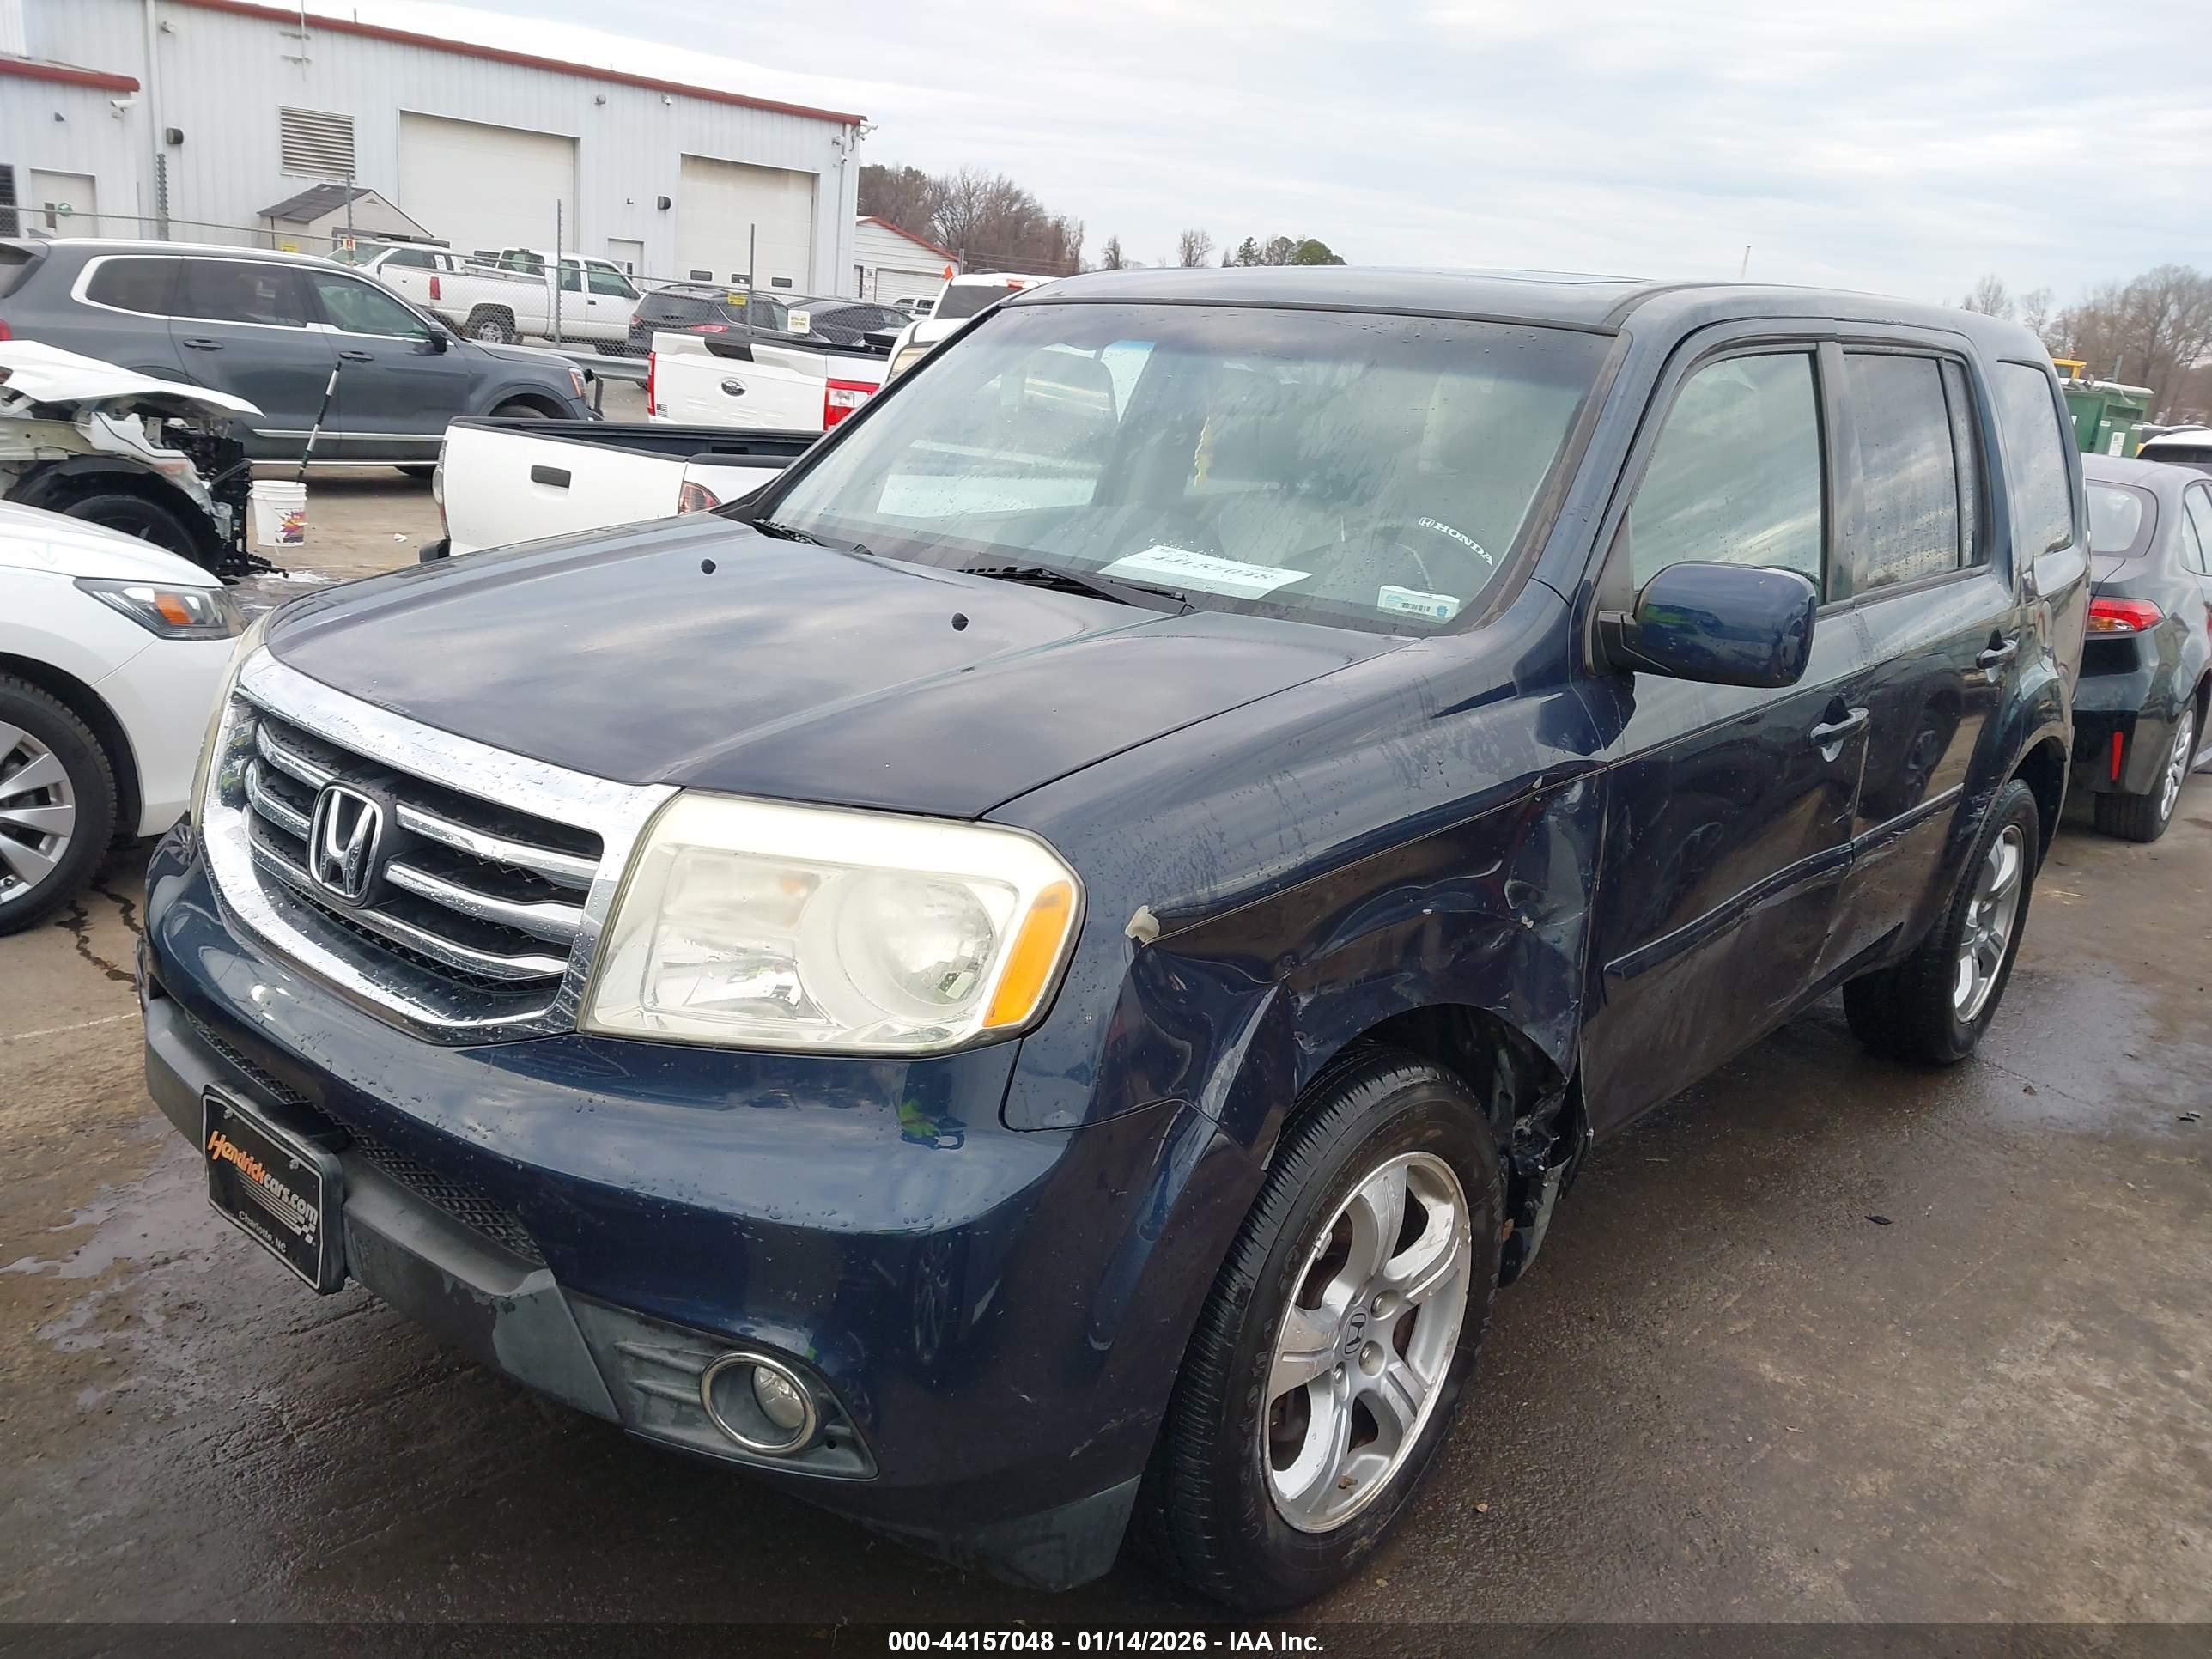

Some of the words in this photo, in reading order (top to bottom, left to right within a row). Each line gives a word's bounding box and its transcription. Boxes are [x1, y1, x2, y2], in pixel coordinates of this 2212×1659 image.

[1433, 521, 1493, 567] HONDA
[207, 1130, 319, 1225] Hendrickcars.com
[239, 1211, 274, 1244] Charlotte,
[275, 1237, 287, 1253] NC
